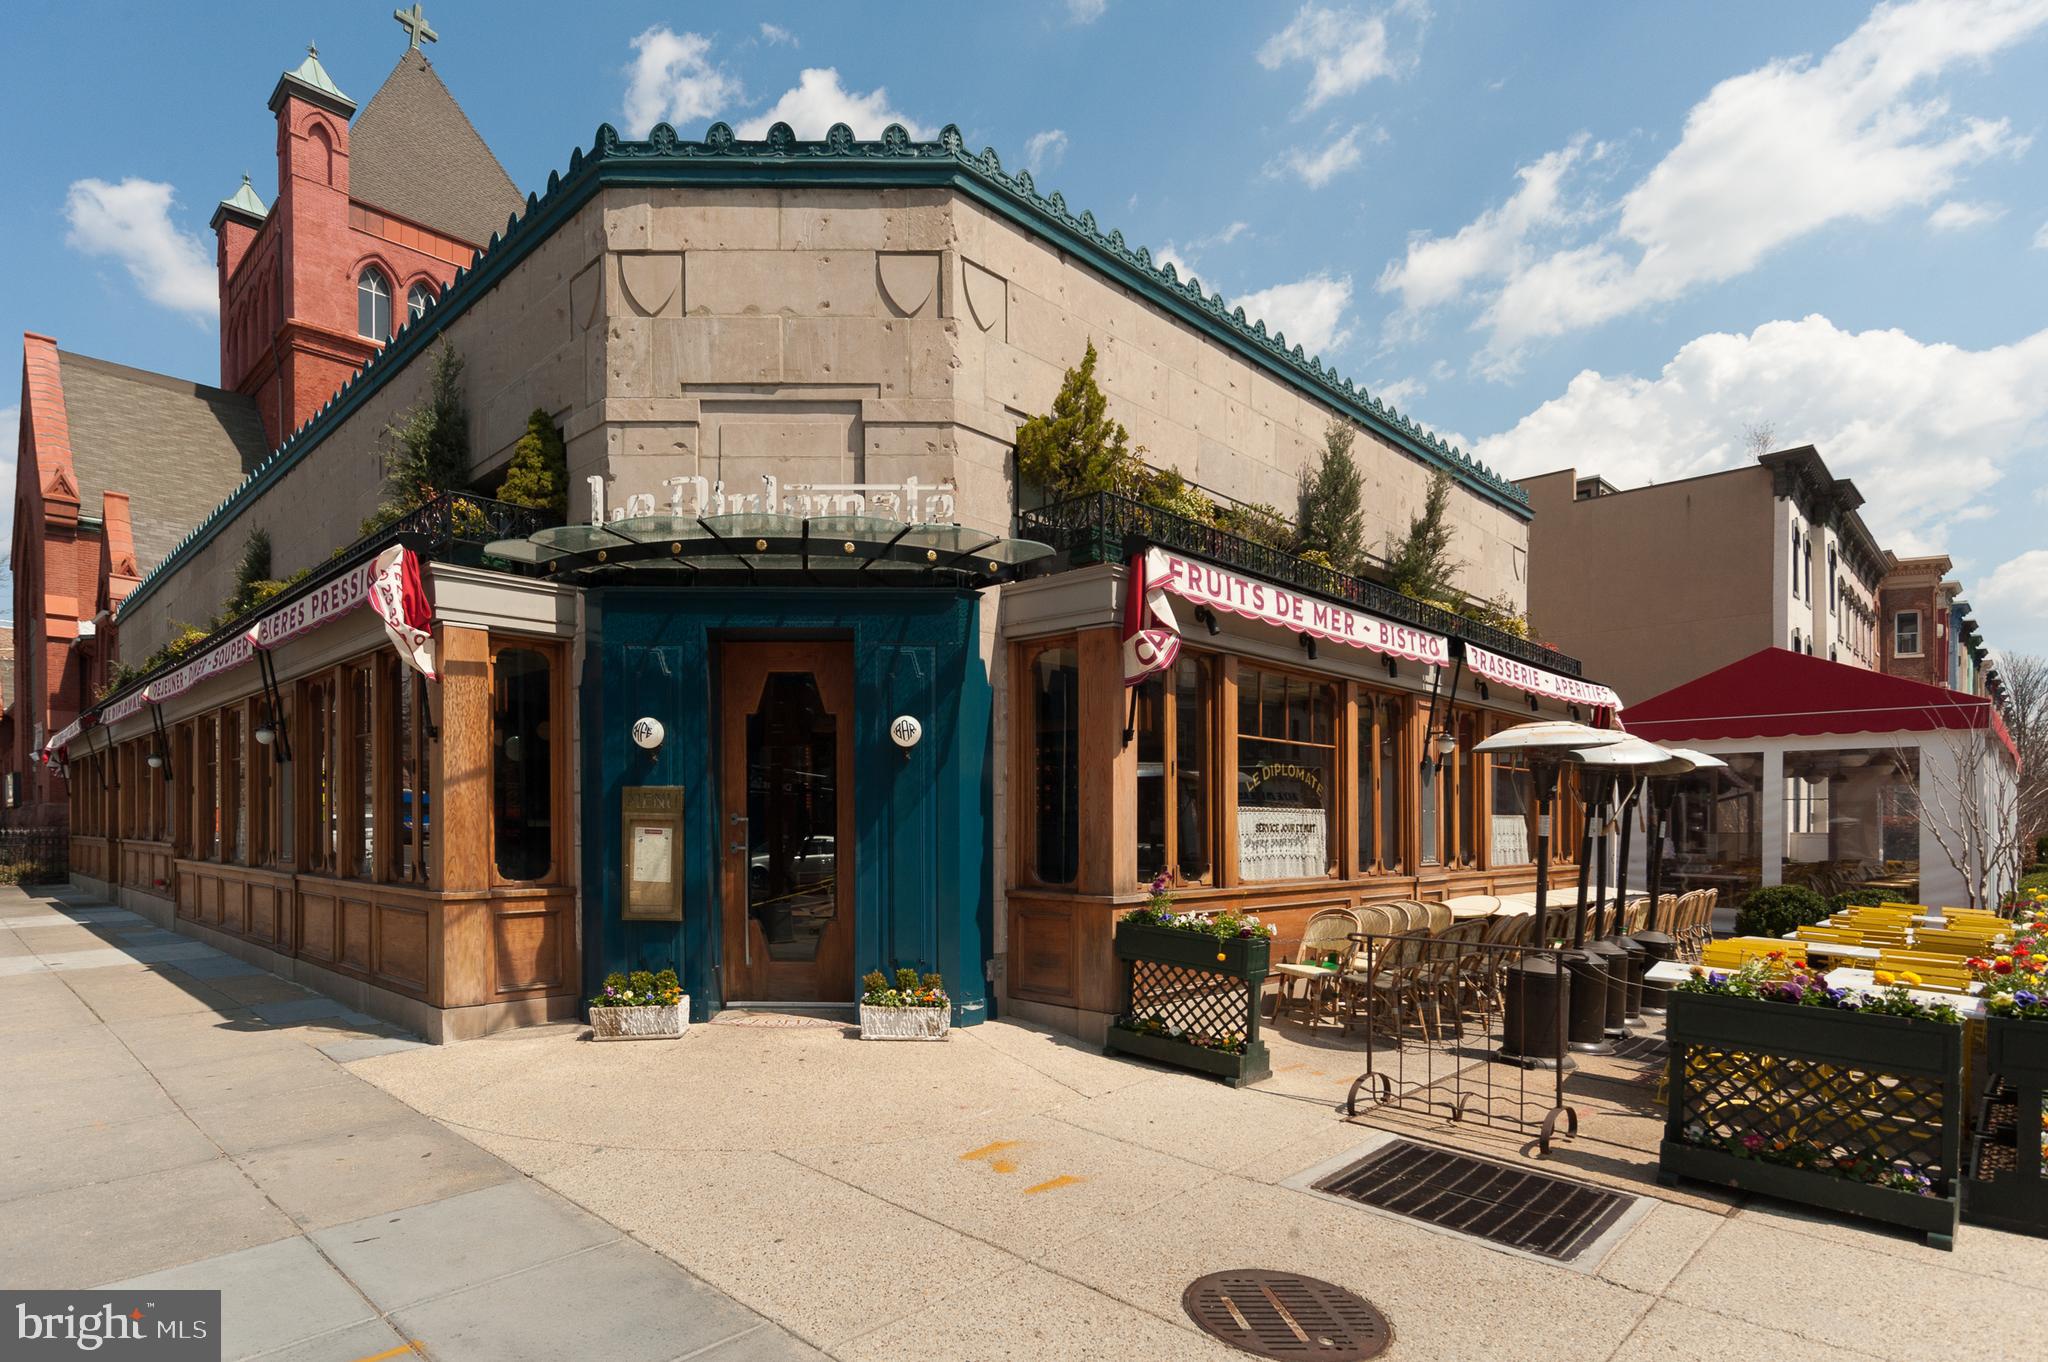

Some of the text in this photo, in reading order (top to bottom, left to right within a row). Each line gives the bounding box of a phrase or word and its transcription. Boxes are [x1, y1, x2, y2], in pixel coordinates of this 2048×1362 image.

[1169, 556, 1441, 657] FRUITS DE MER BISTRO
[212, 637, 249, 670] SOUPER
[895, 719, 917, 741] BAR
[1246, 763, 1325, 798] LE DIPLOMATE
